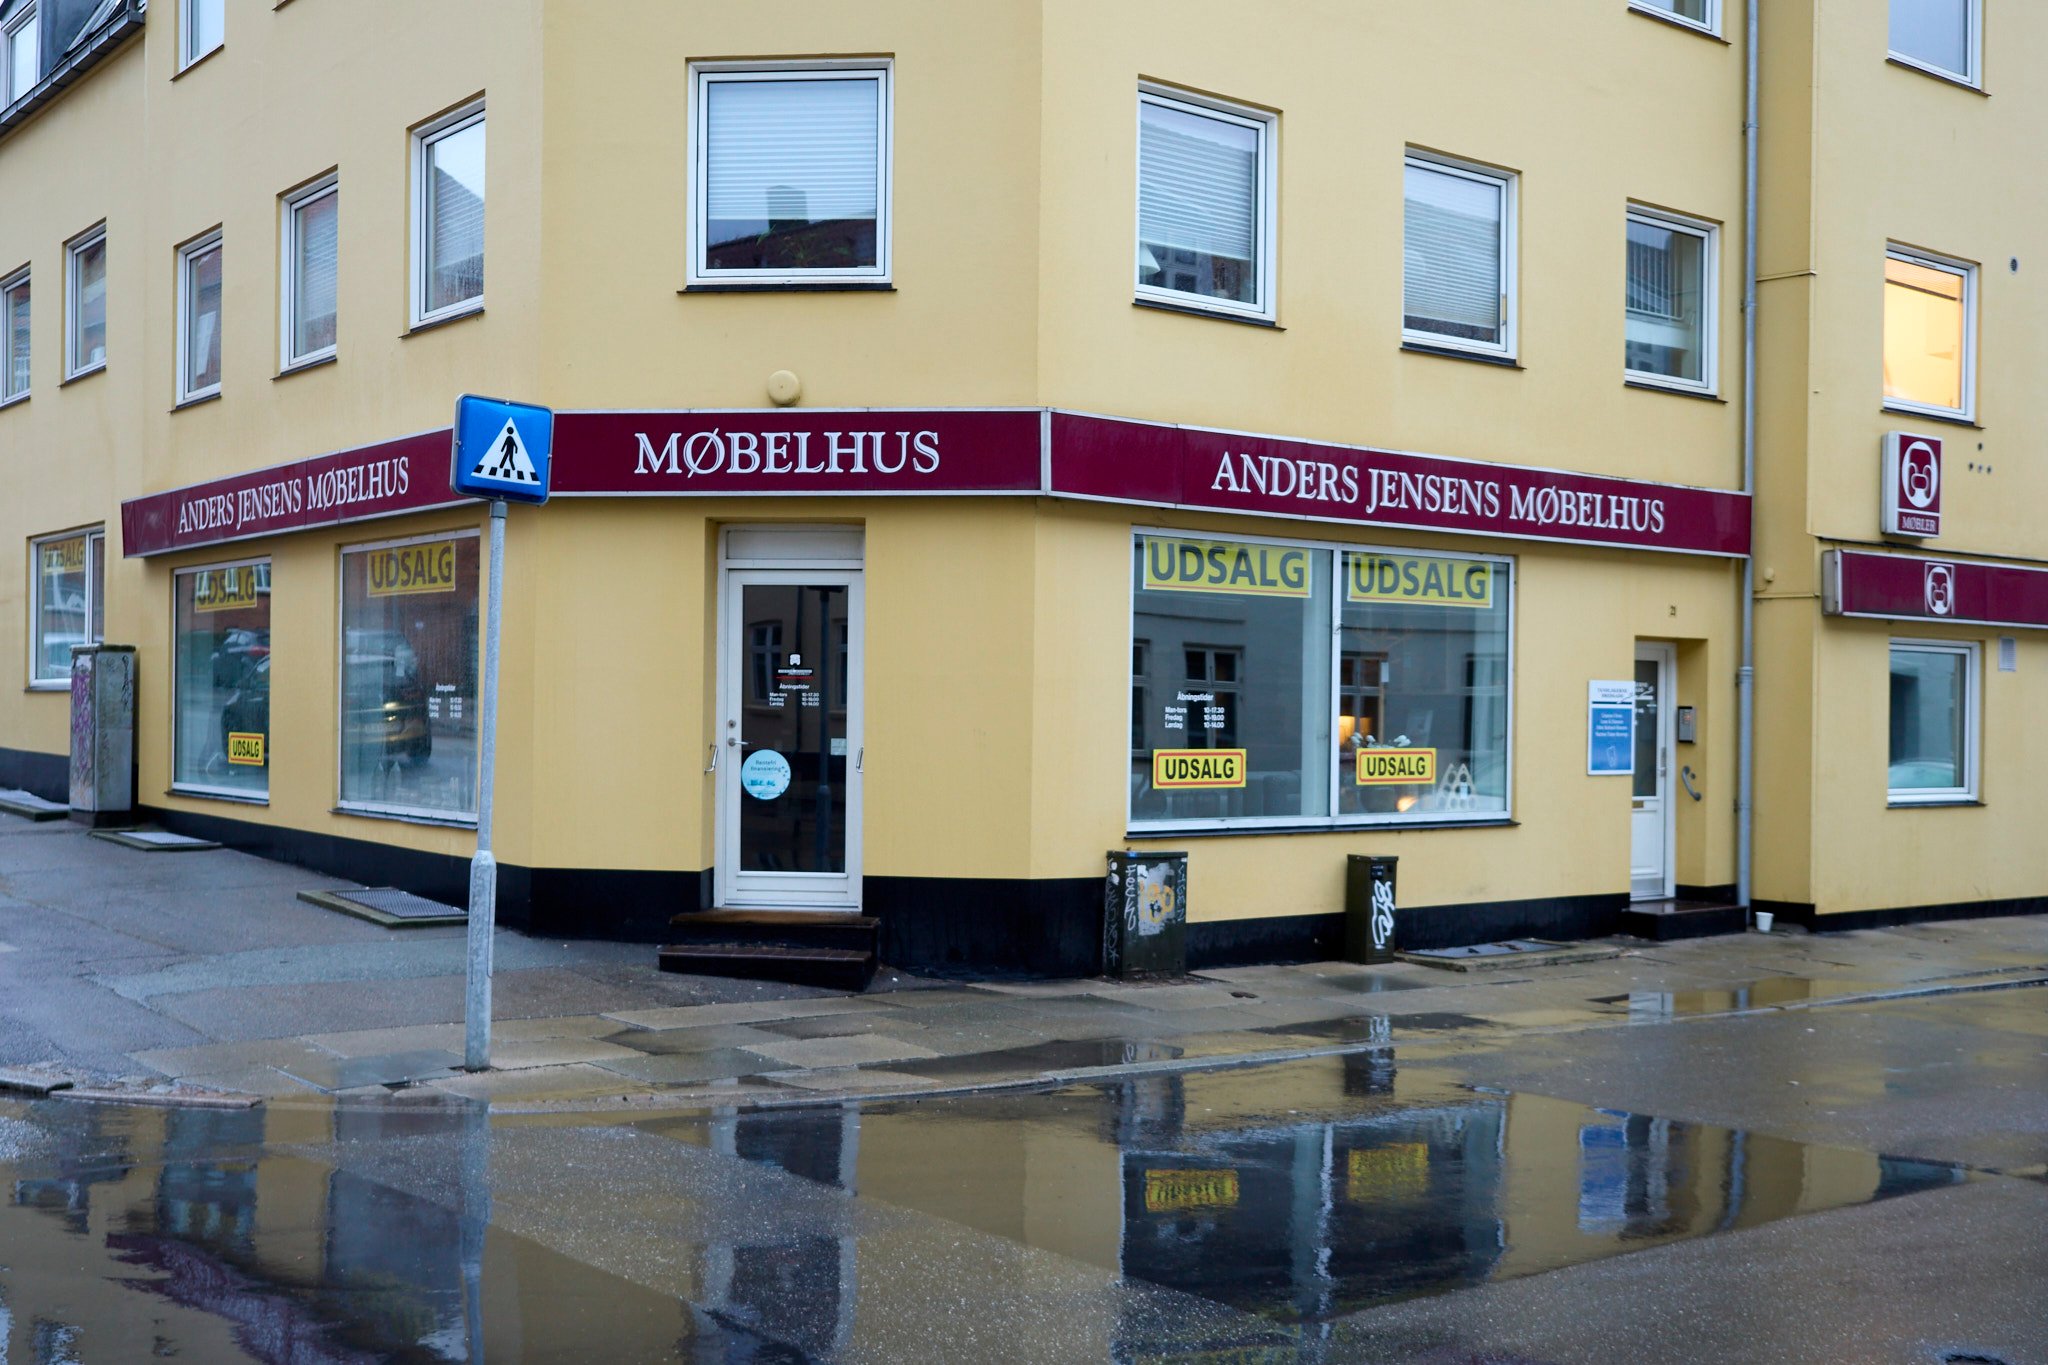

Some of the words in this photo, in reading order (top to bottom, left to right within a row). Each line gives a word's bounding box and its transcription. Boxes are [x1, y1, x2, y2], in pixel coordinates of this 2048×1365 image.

[634, 427, 941, 479] MØBELHUS
[178, 491, 235, 534] ANDERS
[236, 478, 302, 531] JENSENS
[306, 456, 410, 512] MØBELHUS
[1211, 451, 1359, 504] ANDERS
[1366, 468, 1501, 518] JENSENS
[1509, 484, 1665, 534] MØBELHUS
[371, 545, 452, 589] UDSALG
[1151, 541, 1305, 589] UDSALG
[1354, 557, 1487, 600] UDSALG
[232, 739, 260, 758] UDSALG
[1165, 758, 1234, 779] UDSALG
[1367, 756, 1426, 776] UDSALG
